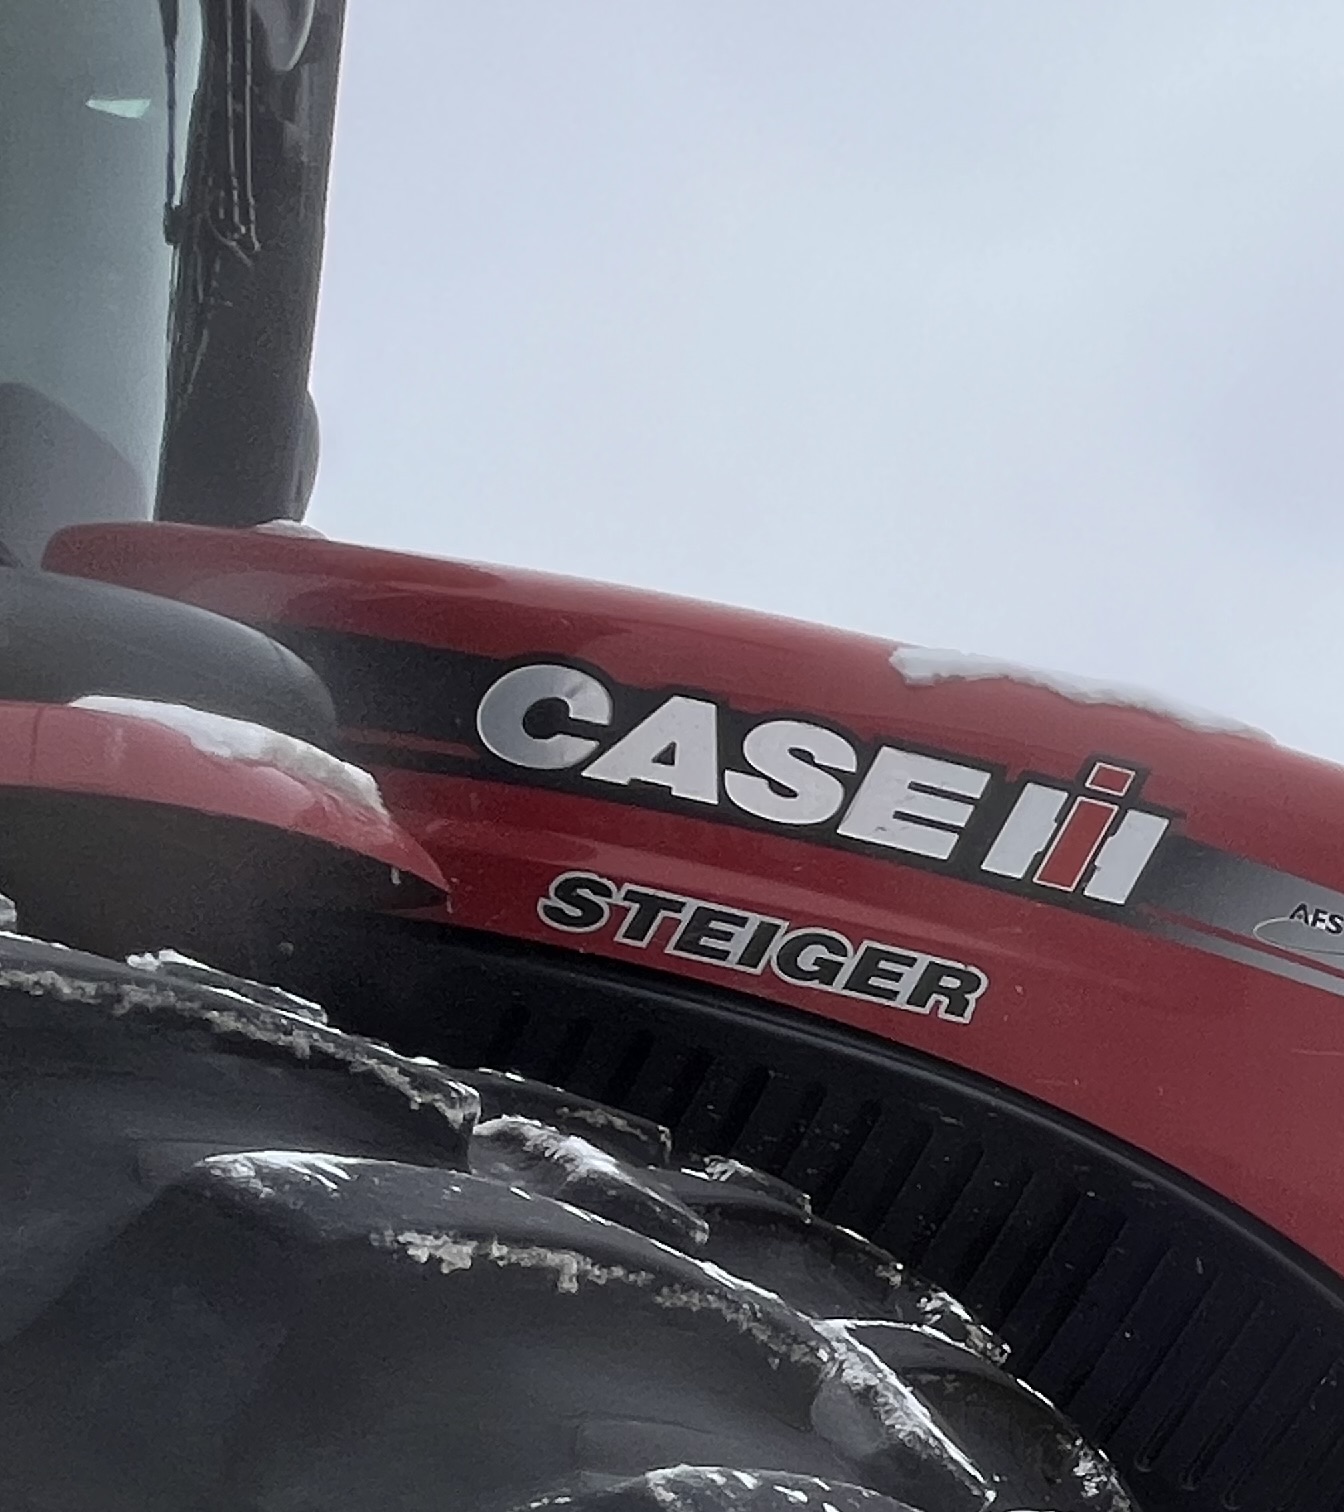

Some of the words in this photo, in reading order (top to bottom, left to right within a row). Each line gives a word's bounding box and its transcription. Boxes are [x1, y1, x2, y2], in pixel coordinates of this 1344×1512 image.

[478, 664, 992, 861] CASE
[538, 872, 988, 1024] STEIGER
[1289, 903, 1344, 934] AFS
